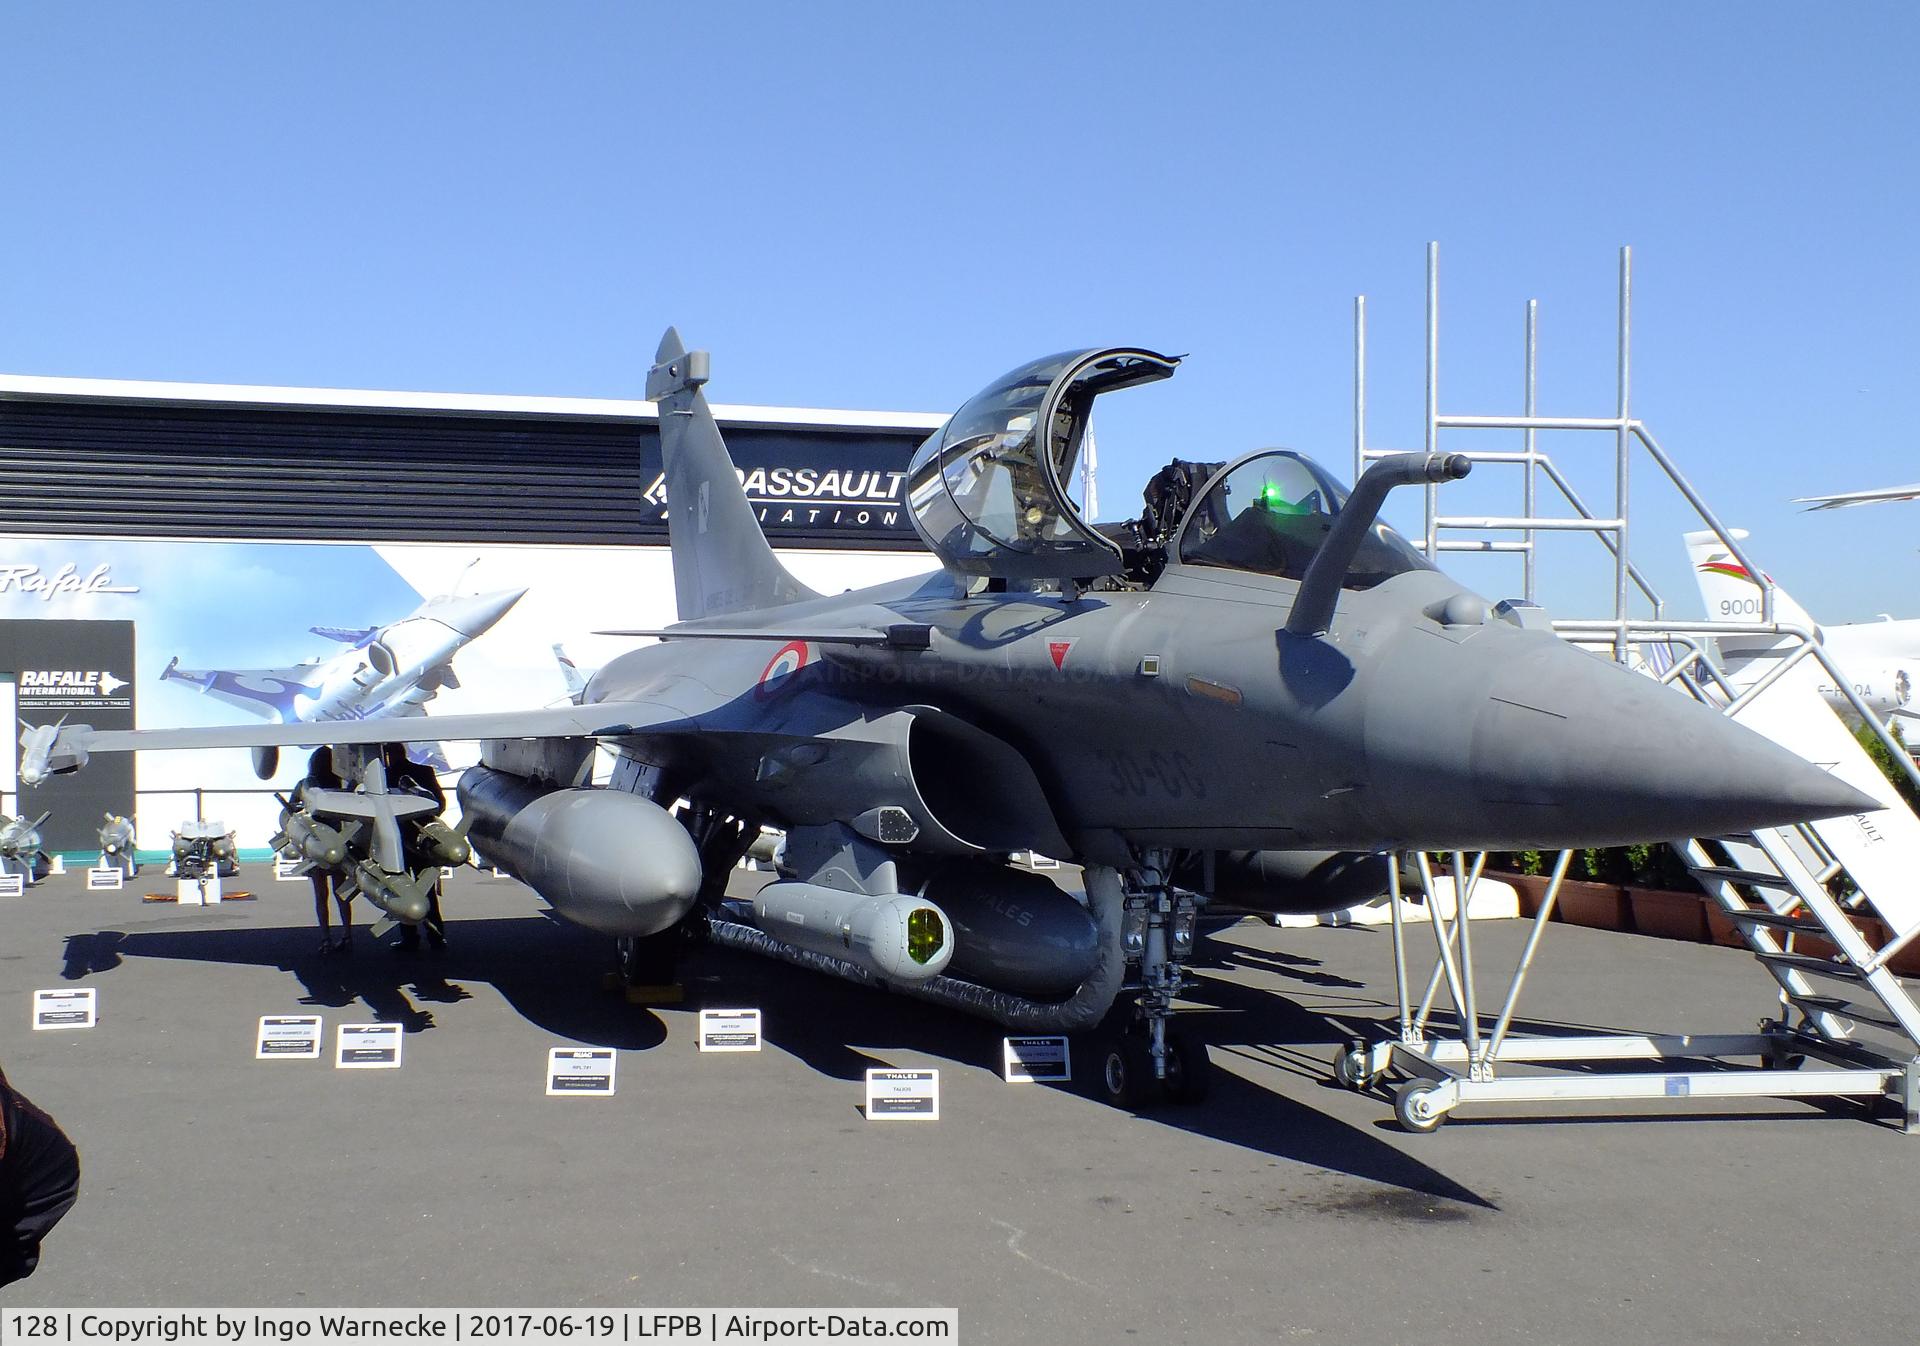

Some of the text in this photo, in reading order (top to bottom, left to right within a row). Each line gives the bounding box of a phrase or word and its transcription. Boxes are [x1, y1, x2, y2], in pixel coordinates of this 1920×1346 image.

[759, 508, 898, 525] IATION
[0, 562, 140, 601] Rafale
[20, 671, 99, 686] RAFALE
[18, 687, 96, 695] INTERNATIONAL
[968, 888, 1035, 928] HALES
